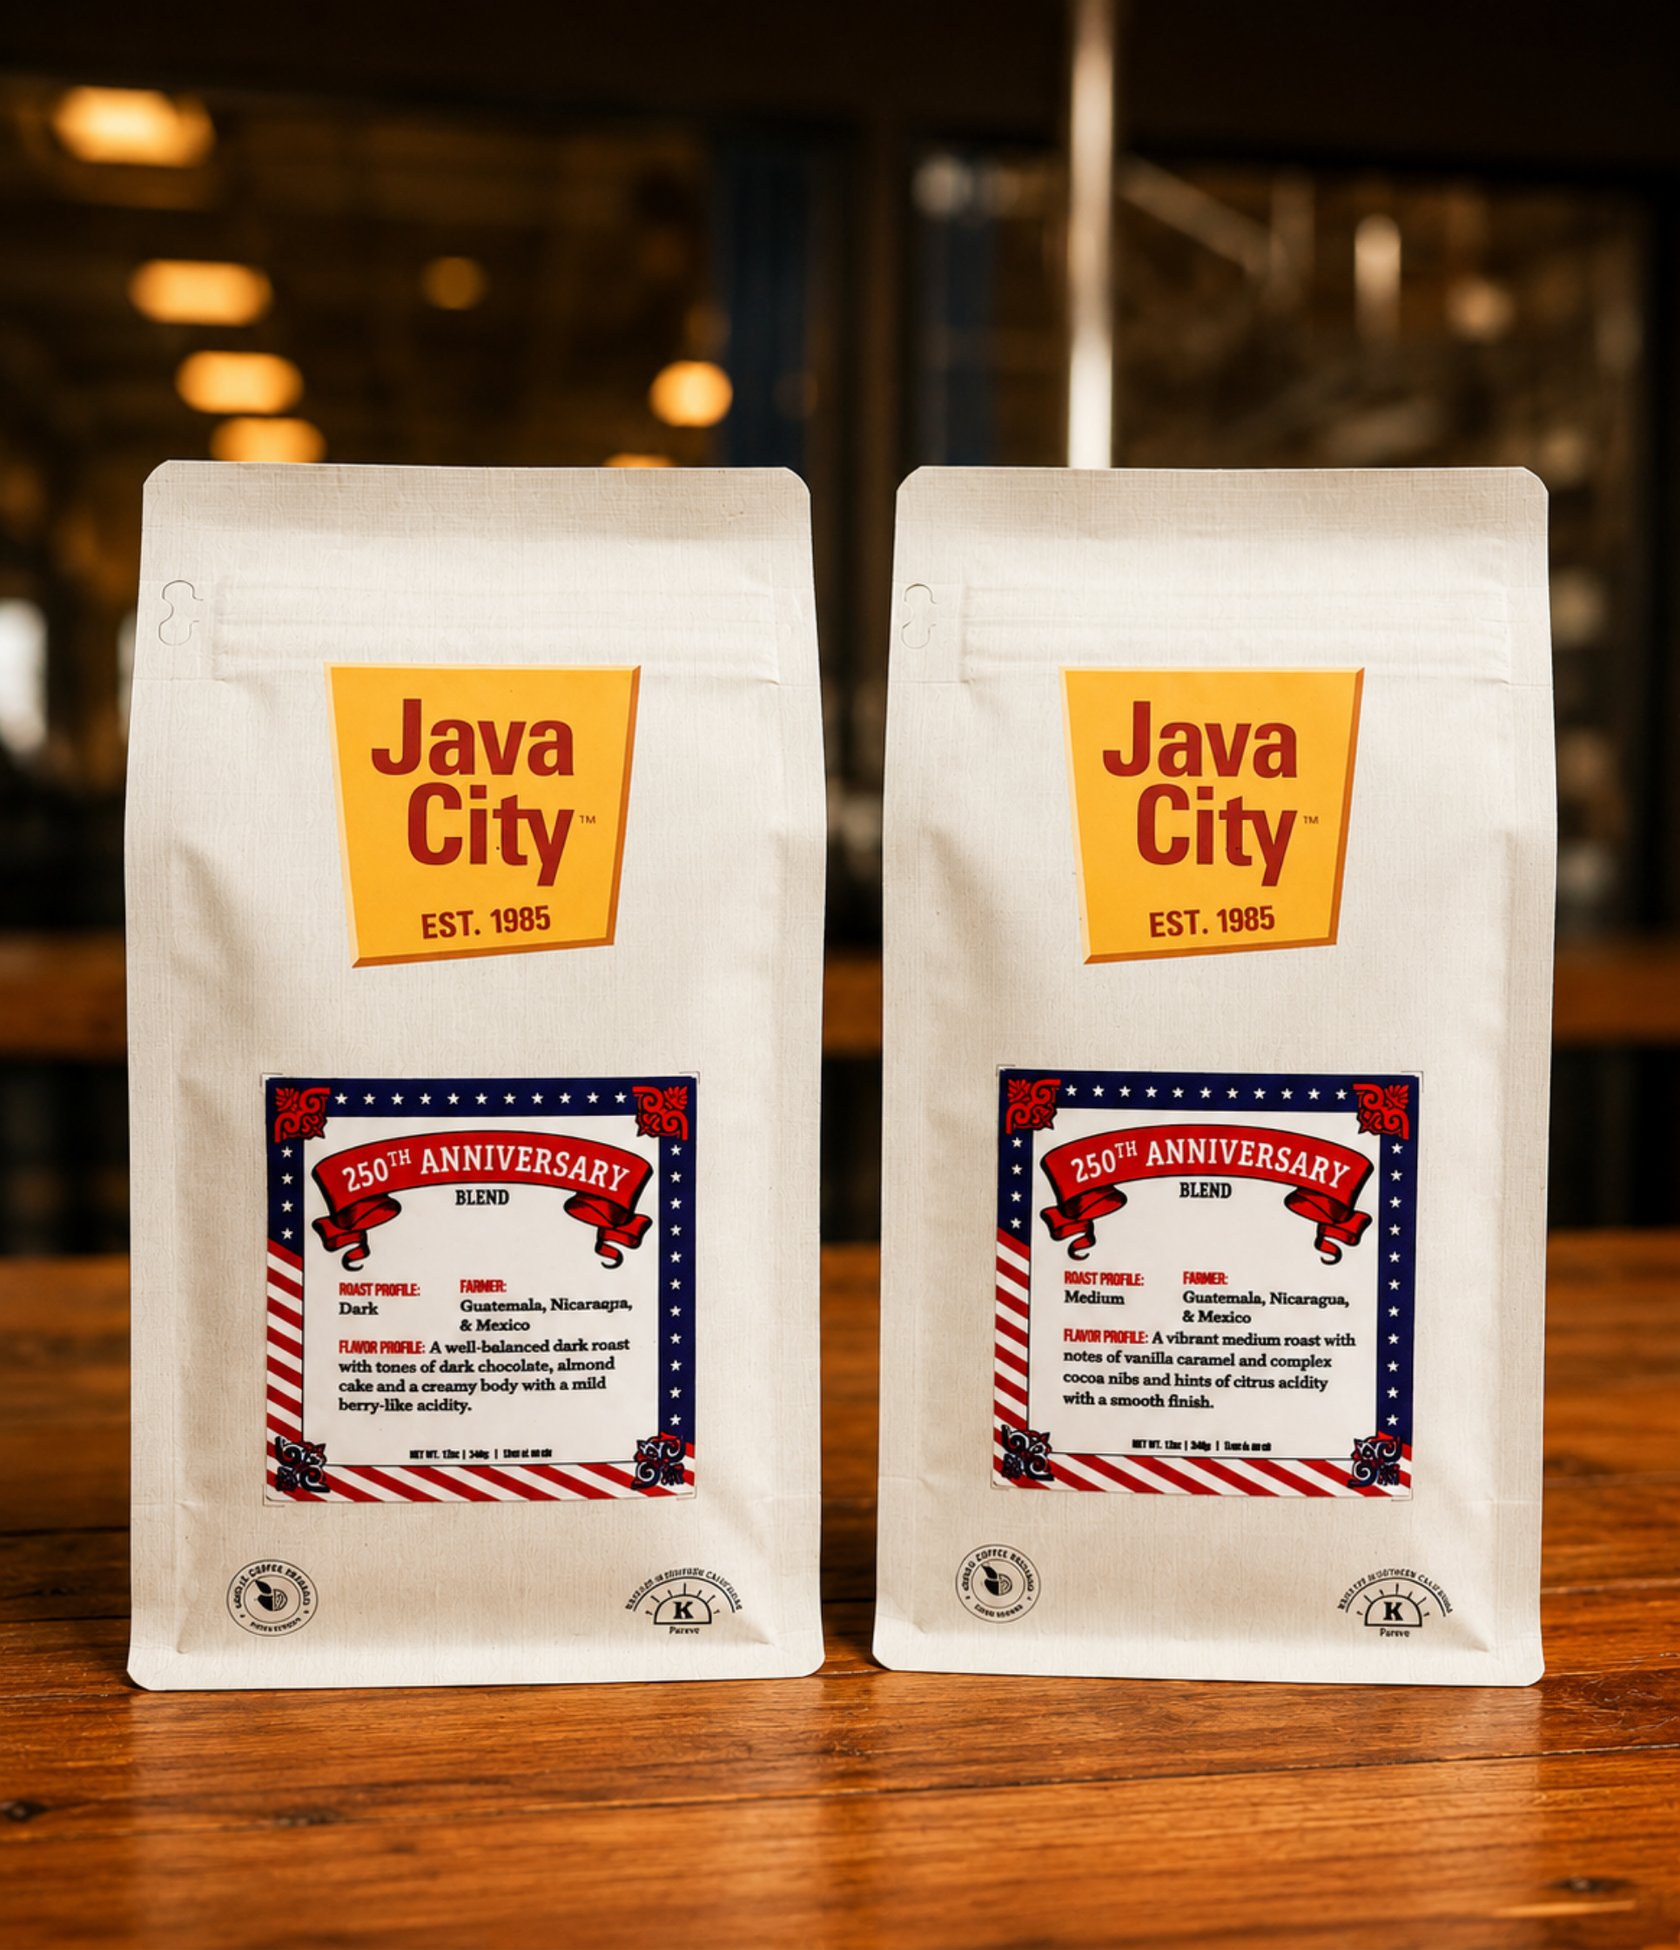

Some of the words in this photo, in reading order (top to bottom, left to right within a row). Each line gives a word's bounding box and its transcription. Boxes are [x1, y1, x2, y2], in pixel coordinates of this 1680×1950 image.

[371, 698, 574, 777] Java
[1102, 700, 1298, 779] Java
[407, 781, 575, 887] City
[1136, 783, 1298, 887] City
[421, 909, 481, 940] EST.
[490, 905, 551, 934] 1985
[1149, 909, 1209, 938] EST.
[1216, 905, 1275, 933] 1985
[420, 1145, 630, 1192] ANNIVERSARY
[1146, 1139, 1351, 1188] ANNIVERSARY
[455, 1188, 510, 1206] BLEND
[1179, 1181, 1233, 1199] BLEND
[459, 1279, 507, 1294] FARMER:
[1064, 1270, 1099, 1285] ROAST
[1099, 1272, 1145, 1287] PROFILE:
[1182, 1270, 1228, 1286] FARMER:
[339, 1282, 374, 1297] ROAST
[374, 1282, 421, 1297] PROFILE:
[1064, 1289, 1126, 1306] Medium
[1182, 1289, 1267, 1307] Guatemala,
[1269, 1291, 1350, 1309] Nicaragua,
[338, 1301, 379, 1316] Dark
[459, 1297, 547, 1314] Guatemala,
[459, 1318, 473, 1332] &
[475, 1318, 531, 1332] Mexico
[1181, 1309, 1195, 1323] &
[1197, 1309, 1252, 1324] Mexico
[338, 1339, 378, 1355] FLAVOR
[379, 1340, 426, 1355] PROFILE:
[428, 1340, 443, 1355] A
[444, 1338, 551, 1354] well-balanced
[552, 1337, 589, 1353] dark
[591, 1338, 631, 1352] roast
[1063, 1328, 1102, 1343] FLAVOR
[1103, 1329, 1149, 1345] PROFILE:
[1151, 1331, 1164, 1345] A
[1165, 1330, 1220, 1346] vibrant
[1221, 1331, 1282, 1347] medium
[1283, 1334, 1322, 1347] roast
[1323, 1332, 1357, 1347] with
[337, 1358, 373, 1374] with
[375, 1361, 417, 1374] tones
[419, 1359, 437, 1374] of
[438, 1358, 476, 1374] dark
[477, 1358, 555, 1375] chocolate,
[556, 1355, 616, 1372] almond
[1063, 1350, 1104, 1364] notes
[1106, 1349, 1123, 1364] of
[1123, 1350, 1174, 1365] vanilla
[1176, 1352, 1236, 1367] caramel
[1238, 1352, 1268, 1368] and
[1269, 1353, 1332, 1372] complex
[338, 1377, 375, 1393] cake
[375, 1378, 407, 1393] and
[408, 1382, 420, 1393] a
[420, 1382, 478, 1396] creamy
[479, 1377, 519, 1395] body
[521, 1377, 557, 1392] with
[559, 1380, 570, 1391] a
[571, 1375, 607, 1391] mild
[1062, 1373, 1106, 1385] cocoa
[1107, 1371, 1140, 1386] nibs
[1142, 1372, 1172, 1387] and
[1173, 1372, 1213, 1388] hints
[1214, 1373, 1233, 1388] of
[1233, 1374, 1276, 1389] citrus
[1278, 1374, 1329, 1393] acidity
[338, 1396, 414, 1416] berry-like
[416, 1397, 473, 1416] acidity.
[1062, 1390, 1096, 1406] with
[1097, 1396, 1108, 1406] a
[1109, 1393, 1166, 1408] smooth
[1167, 1393, 1215, 1409] finish.
[673, 1601, 694, 1620] K
[1383, 1601, 1404, 1622] K
